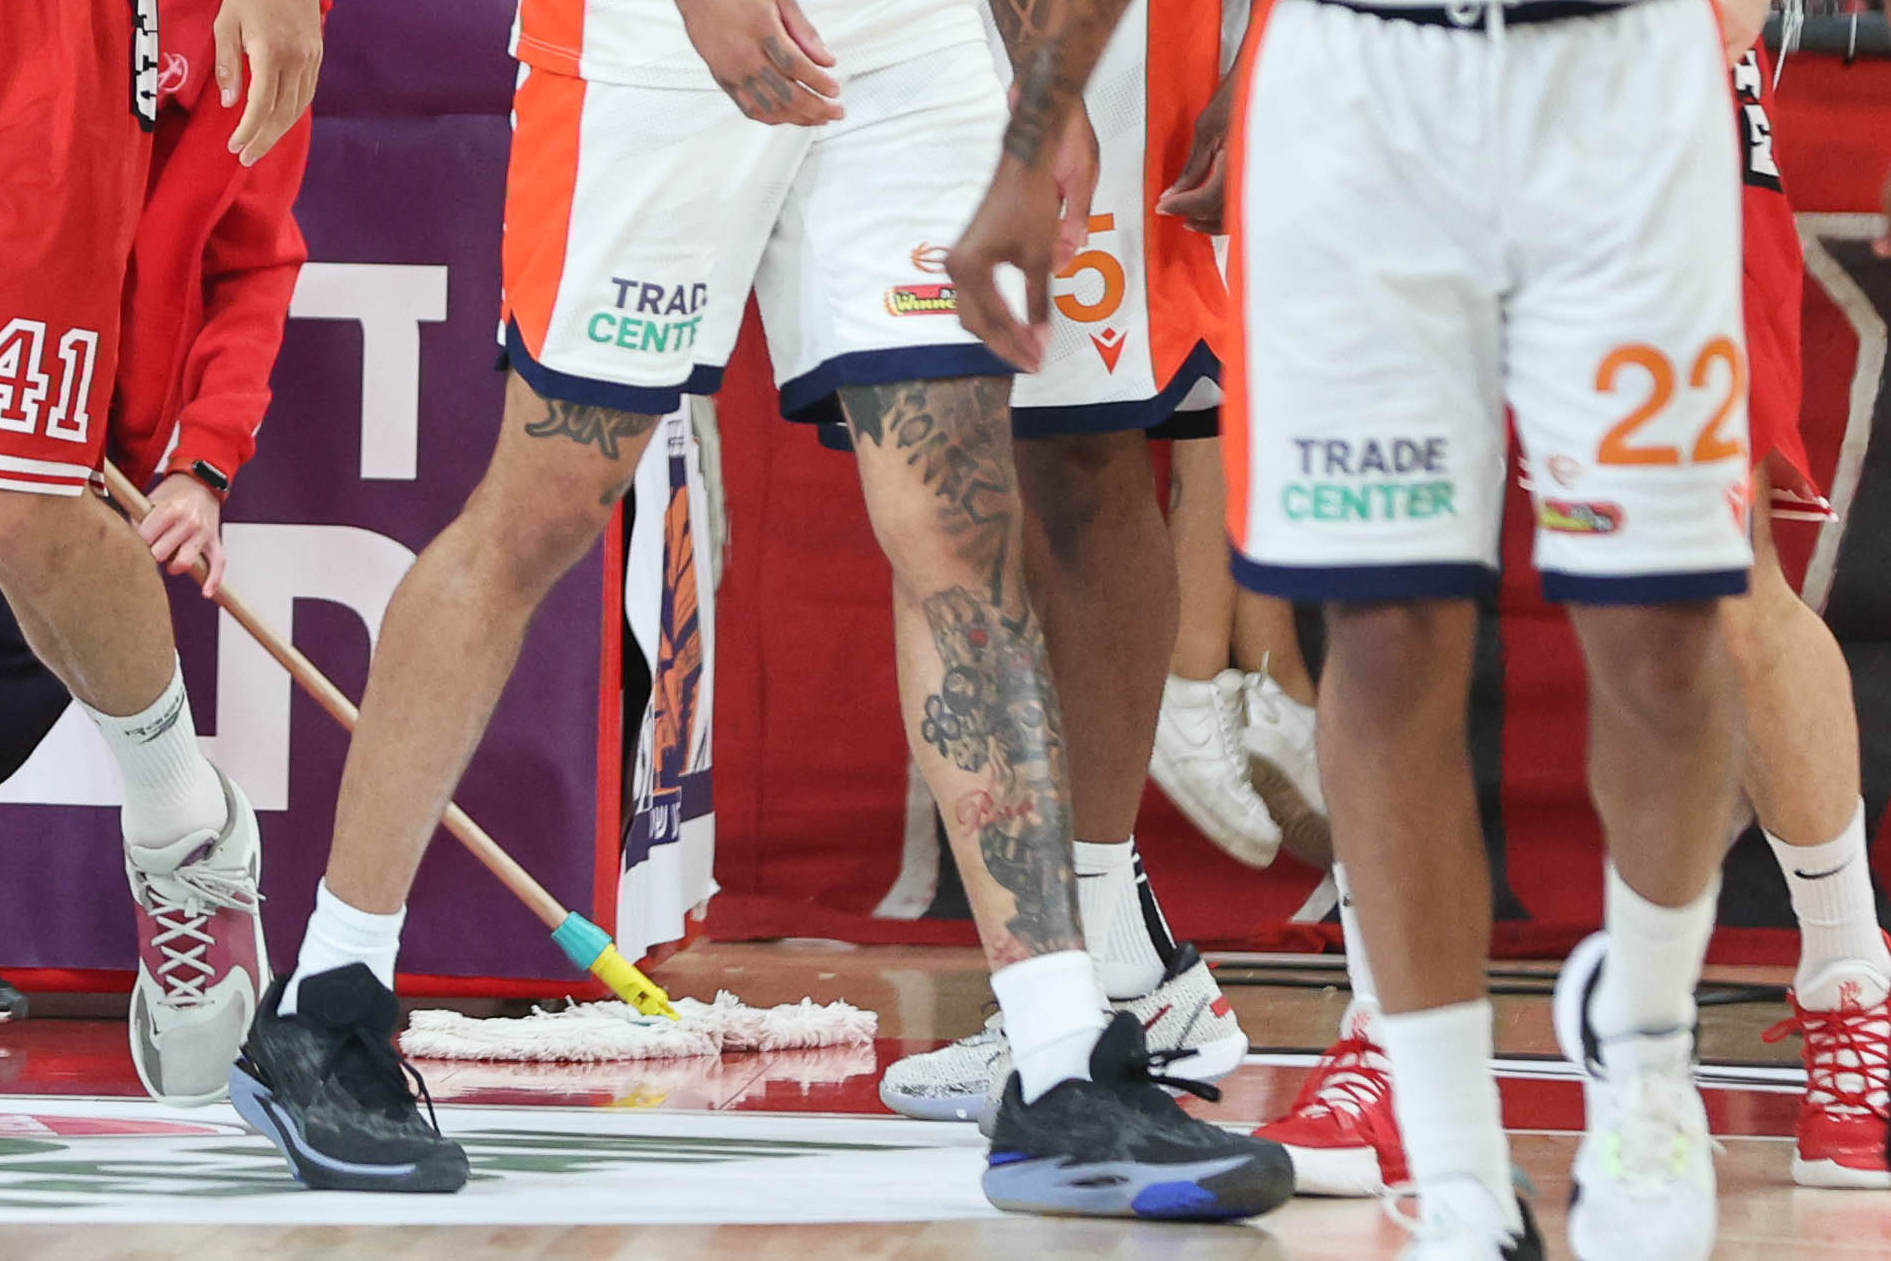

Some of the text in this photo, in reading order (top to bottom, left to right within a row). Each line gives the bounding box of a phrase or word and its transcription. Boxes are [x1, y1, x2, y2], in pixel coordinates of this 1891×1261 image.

[1593, 335, 1744, 466] 22
[1294, 437, 1448, 476] TRADE
[1281, 481, 1459, 522] CENTER
